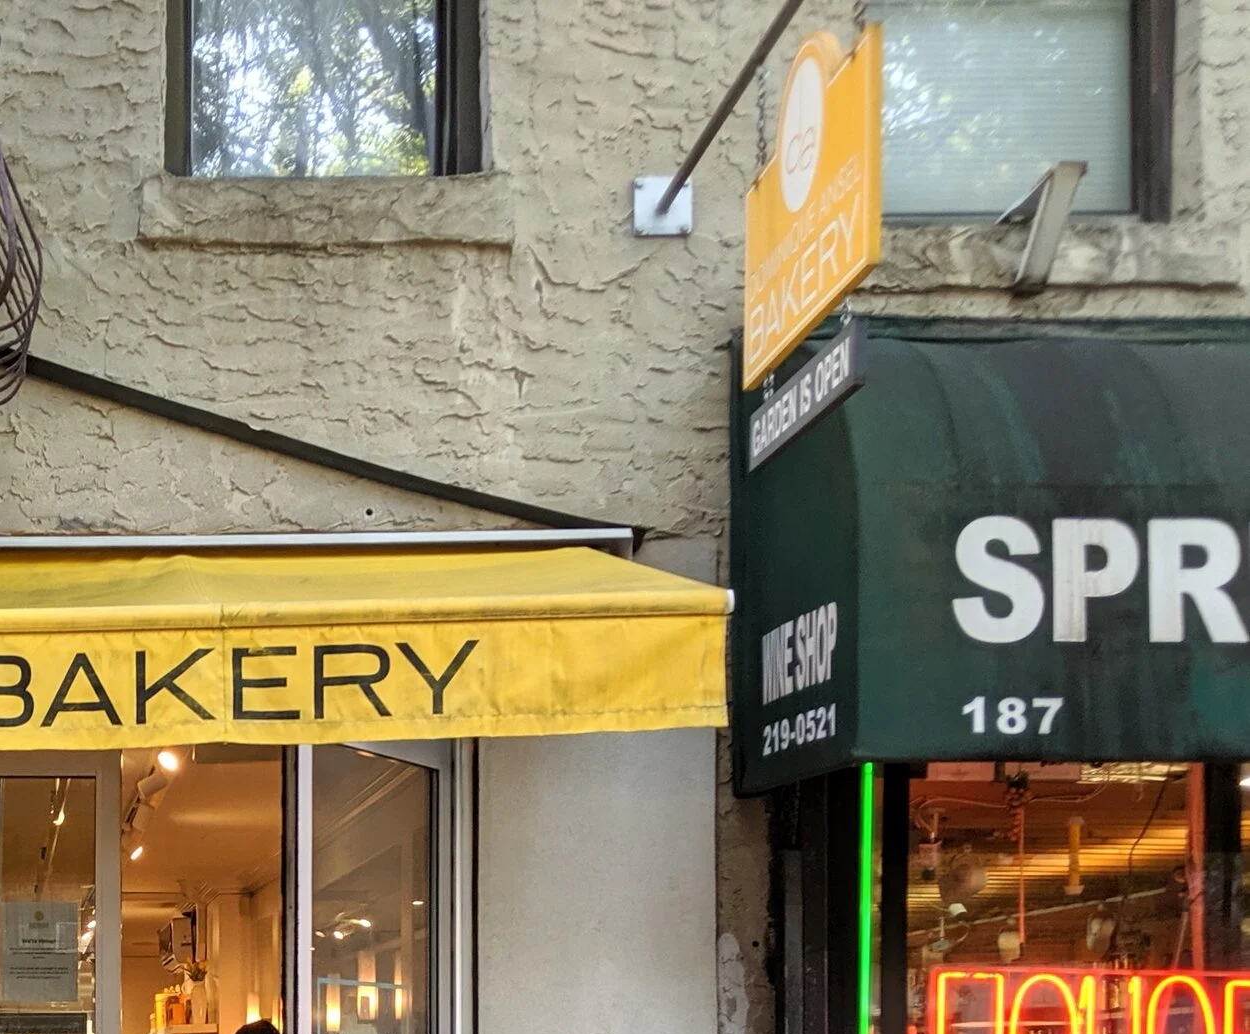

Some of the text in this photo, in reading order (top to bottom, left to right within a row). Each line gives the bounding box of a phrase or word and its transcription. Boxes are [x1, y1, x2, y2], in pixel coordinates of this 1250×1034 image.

[817, 153, 863, 222] ANSEL
[750, 191, 862, 368] BAKERY
[753, 335, 851, 458] GARDEN IS OPEN
[762, 601, 838, 706] WINE SHOP
[762, 702, 838, 758] 219-0521
[961, 696, 1065, 736] 187
